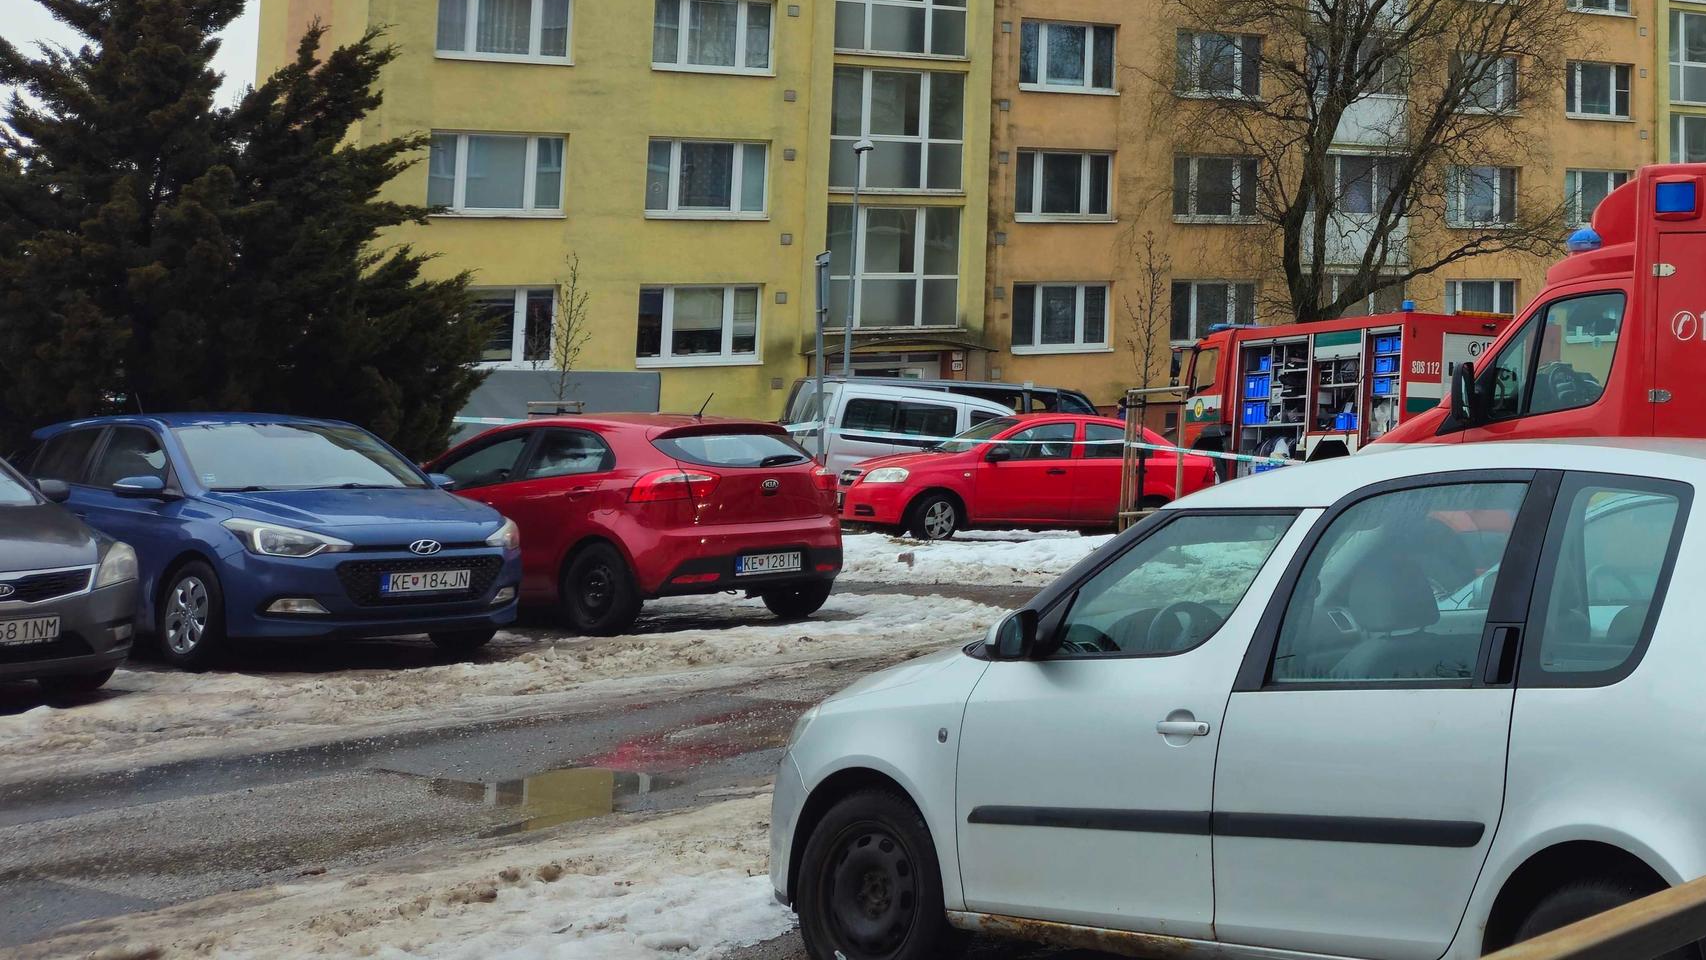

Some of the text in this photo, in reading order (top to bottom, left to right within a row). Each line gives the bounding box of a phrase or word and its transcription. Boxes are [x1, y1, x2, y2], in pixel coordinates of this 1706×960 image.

[1411, 360, 1440, 375] SOS 112
[743, 556, 758, 571] KE
[391, 571, 469, 590] KE 184JN
